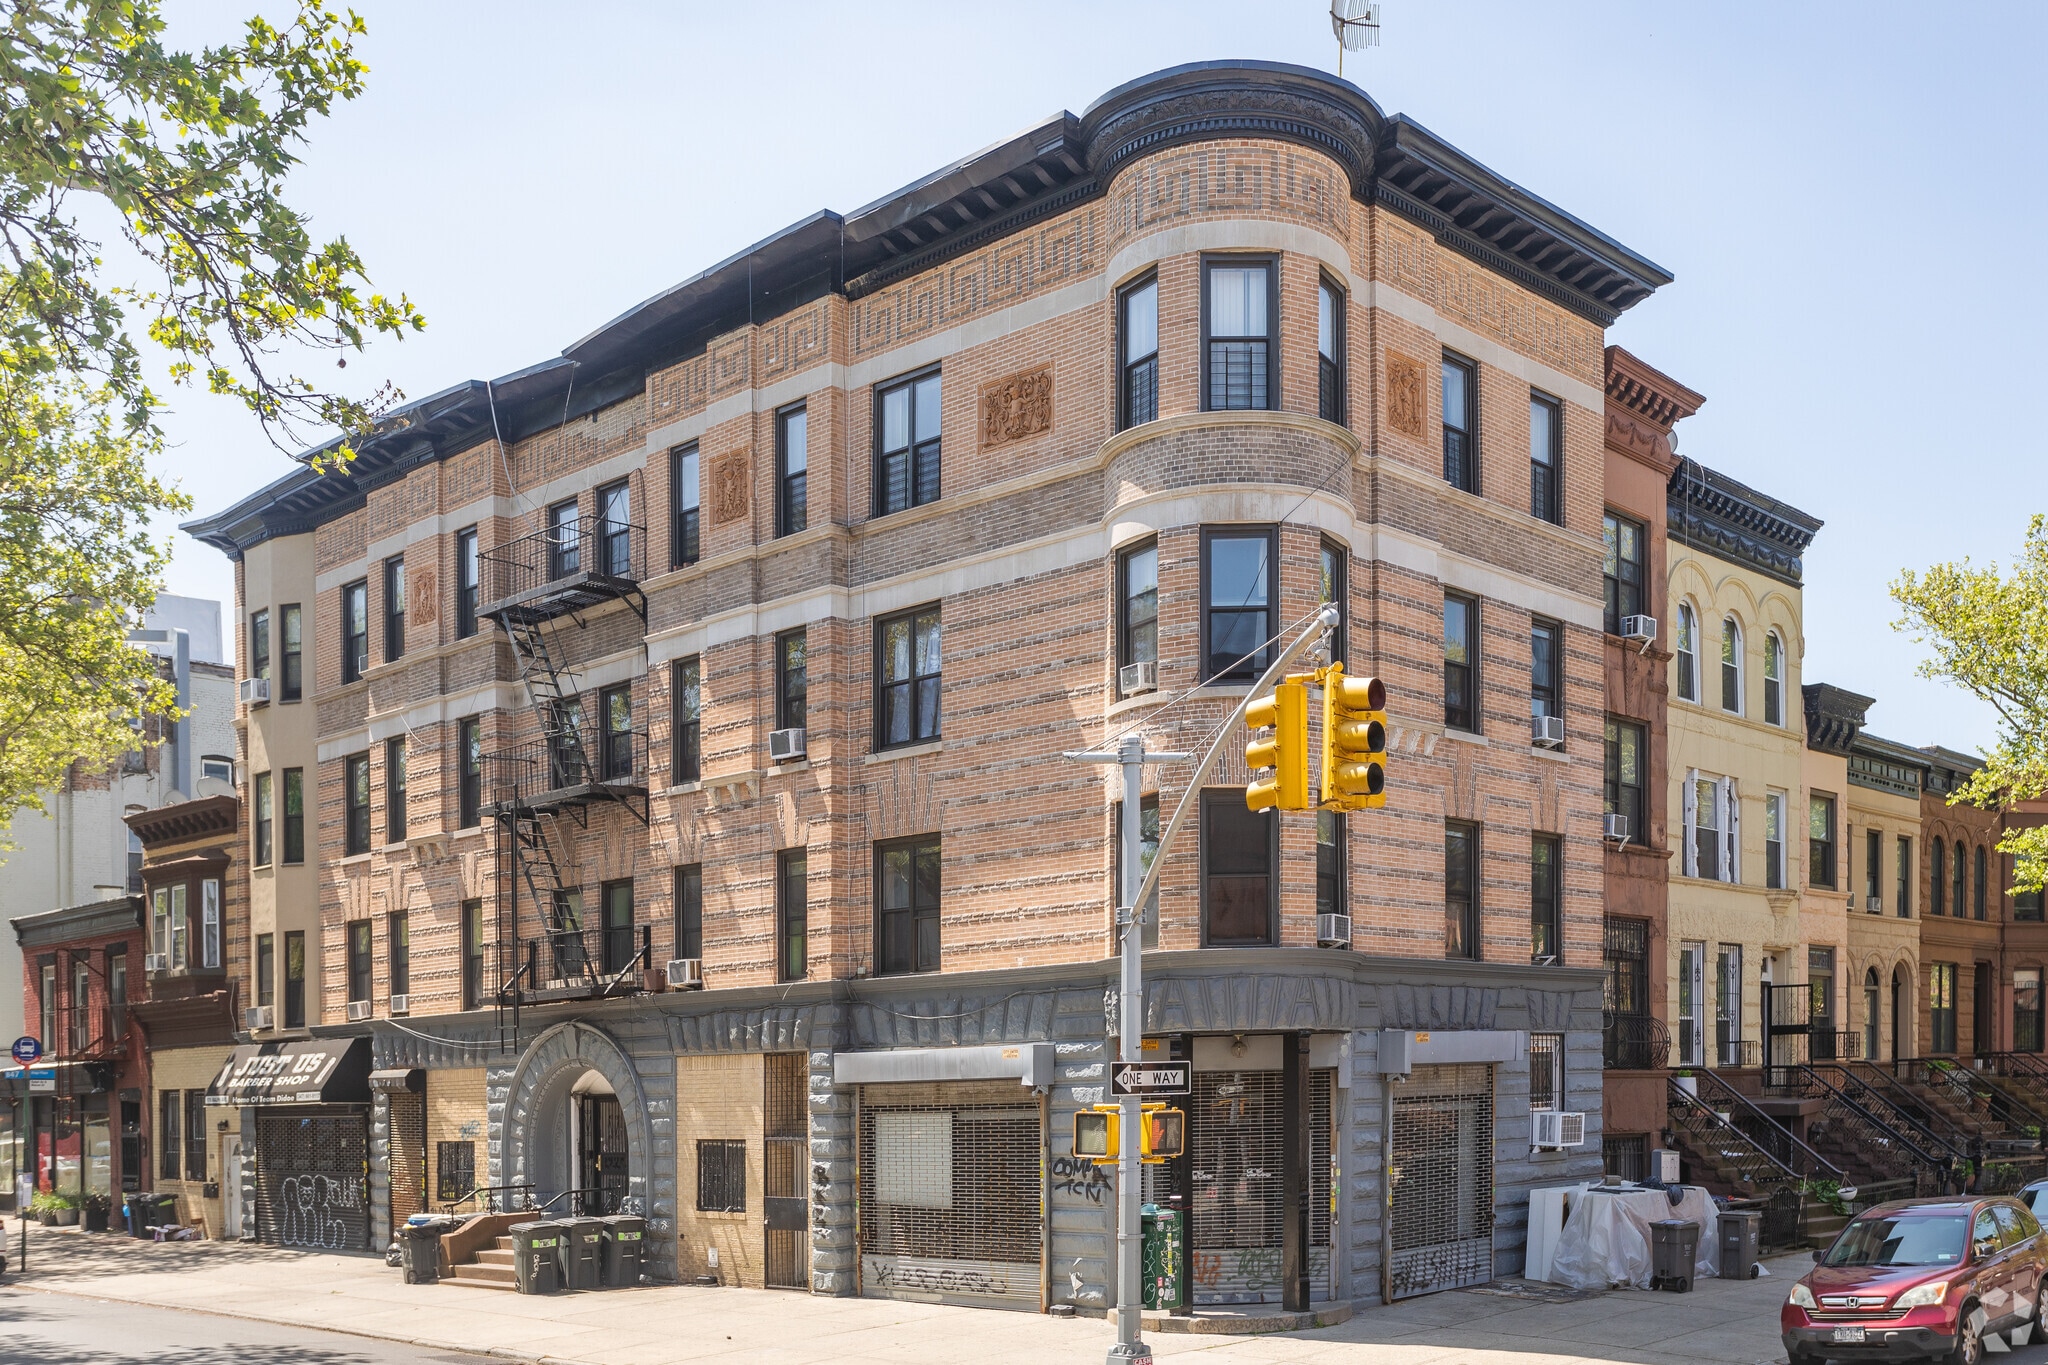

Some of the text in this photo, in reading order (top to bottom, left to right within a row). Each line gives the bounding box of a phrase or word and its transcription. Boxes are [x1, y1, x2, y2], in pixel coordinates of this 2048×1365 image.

[234, 1052, 327, 1076] JUST US
[228, 1075, 310, 1088] BARBER SHOP
[1122, 1072, 1178, 1085] ONE WAY
[251, 1095, 258, 1103] Of
[259, 1095, 276, 1103] Team
